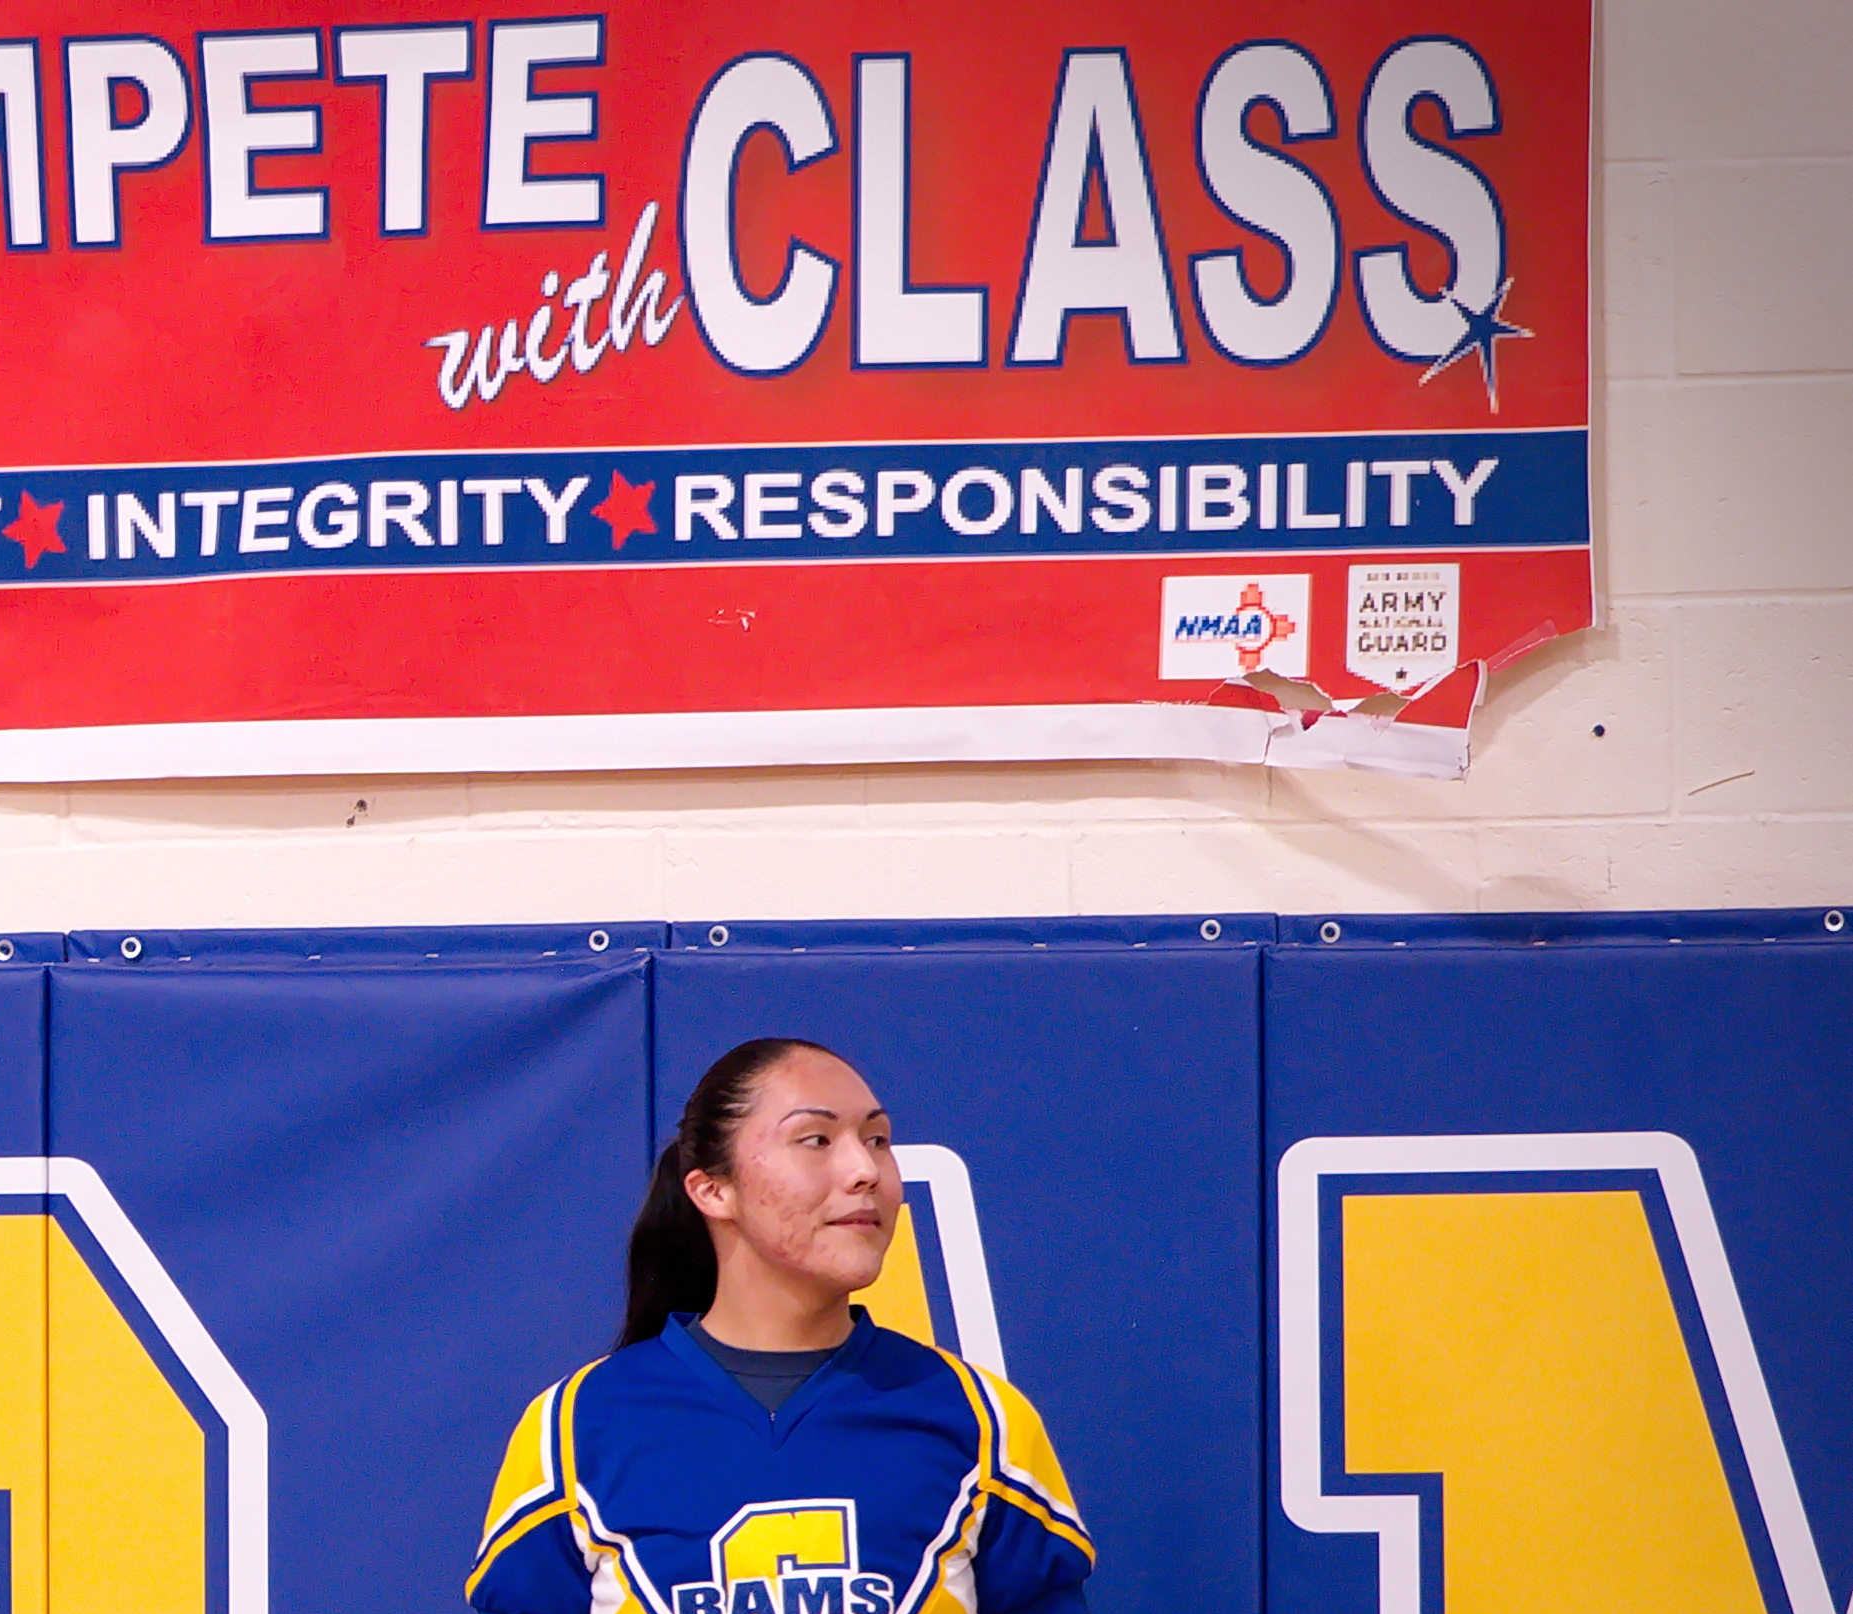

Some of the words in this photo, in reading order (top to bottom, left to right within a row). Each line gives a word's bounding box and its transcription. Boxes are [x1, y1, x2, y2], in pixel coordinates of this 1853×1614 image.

[421, 200, 685, 411] with
[677, 34, 1506, 376] CLASS
[88, 475, 591, 561] INTEGRITY
[673, 457, 1499, 543] RESPONSIBILITY
[1359, 591, 1446, 613] ARMY
[1174, 613, 1263, 638] NMAA
[1358, 631, 1447, 652] GUARD
